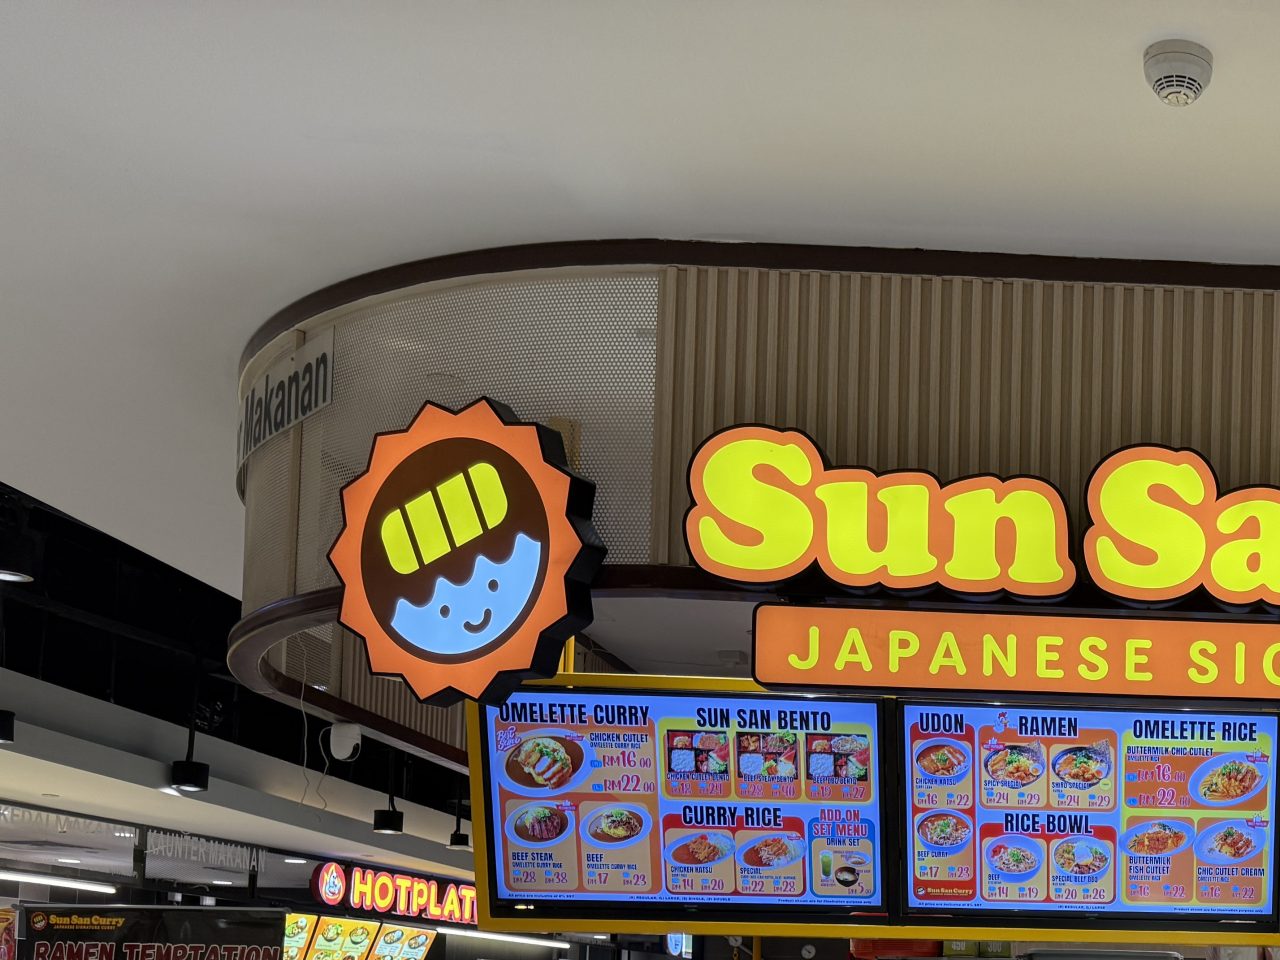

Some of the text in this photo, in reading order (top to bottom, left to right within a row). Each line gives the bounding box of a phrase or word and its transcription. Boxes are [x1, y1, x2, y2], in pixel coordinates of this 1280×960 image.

[697, 437, 1066, 587] Sun
[787, 626, 1154, 683] JAPANESE
[499, 702, 650, 726] OMELETTE CURRY
[696, 707, 832, 732] SUN SAN BENTO
[919, 712, 964, 733] UDON
[1018, 715, 1078, 737] RAMEN
[1132, 719, 1257, 742] OMELETTE RICE
[589, 732, 621, 742] CHICKEN
[623, 733, 648, 743] CUTLET
[1126, 745, 1214, 757] BUTTERMILK CHIC CUTLET
[682, 805, 783, 828] CURRY RICE
[819, 808, 860, 822] ADD ON
[1004, 813, 1093, 834] RICE BOWL
[813, 823, 868, 837] SET MENU
[147, 828, 266, 873] KAUNTER MAKANAN
[511, 852, 554, 862] BEEF STEAK
[586, 853, 604, 863] BEEF
[1129, 856, 1171, 865] BUTTERMILK
[1129, 865, 1170, 875] FISH CUTLET
[1197, 867, 1265, 877] CHIC CUTLET CREAM
